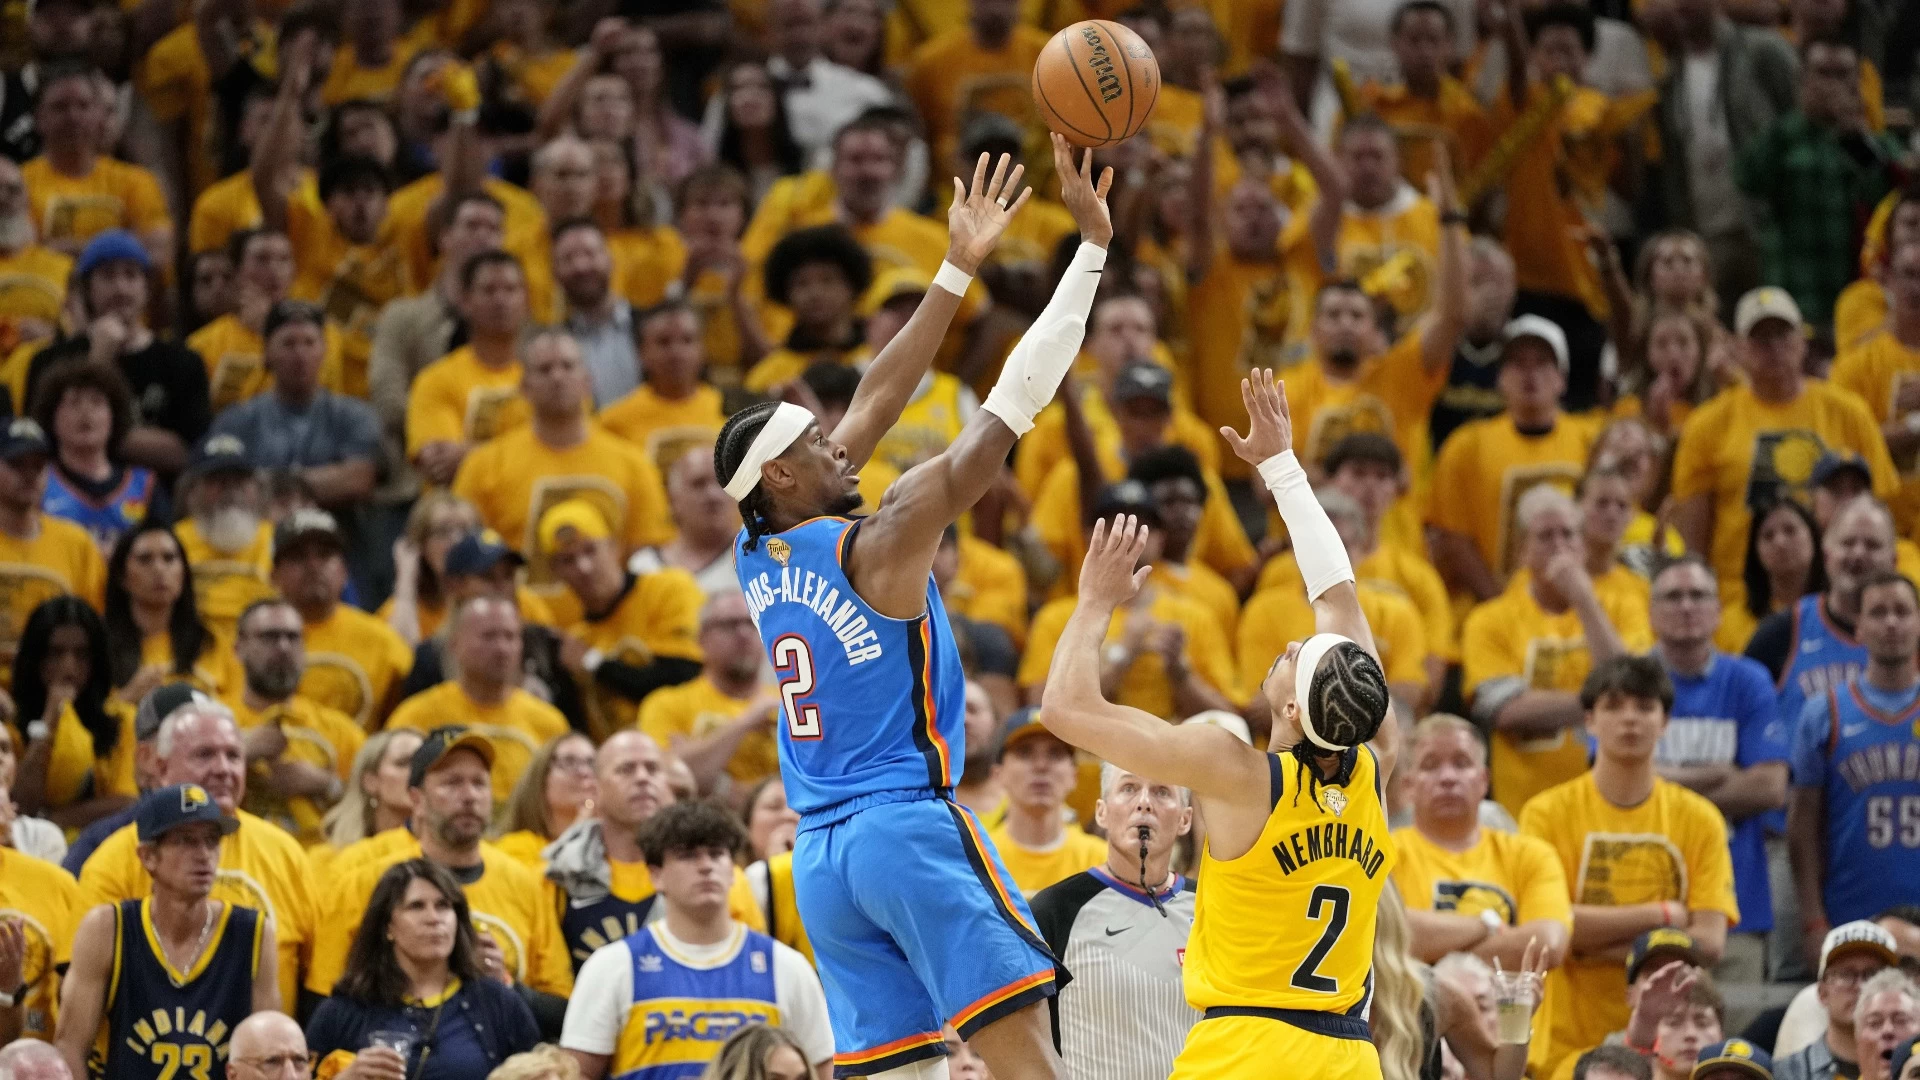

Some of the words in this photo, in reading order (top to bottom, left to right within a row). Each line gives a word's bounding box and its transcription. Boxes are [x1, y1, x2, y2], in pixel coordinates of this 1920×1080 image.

[1081, 27, 1122, 104] Wilson
[767, 542, 790, 556] Finals
[745, 567, 882, 666] OUS-ALEXANDER
[772, 632, 823, 741] 2
[1839, 742, 1920, 794] THUND
[1867, 796, 1920, 849] 55
[1272, 823, 1385, 880] NEMBHARD
[1290, 884, 1350, 994] 2
[151, 1041, 213, 1080] 23
